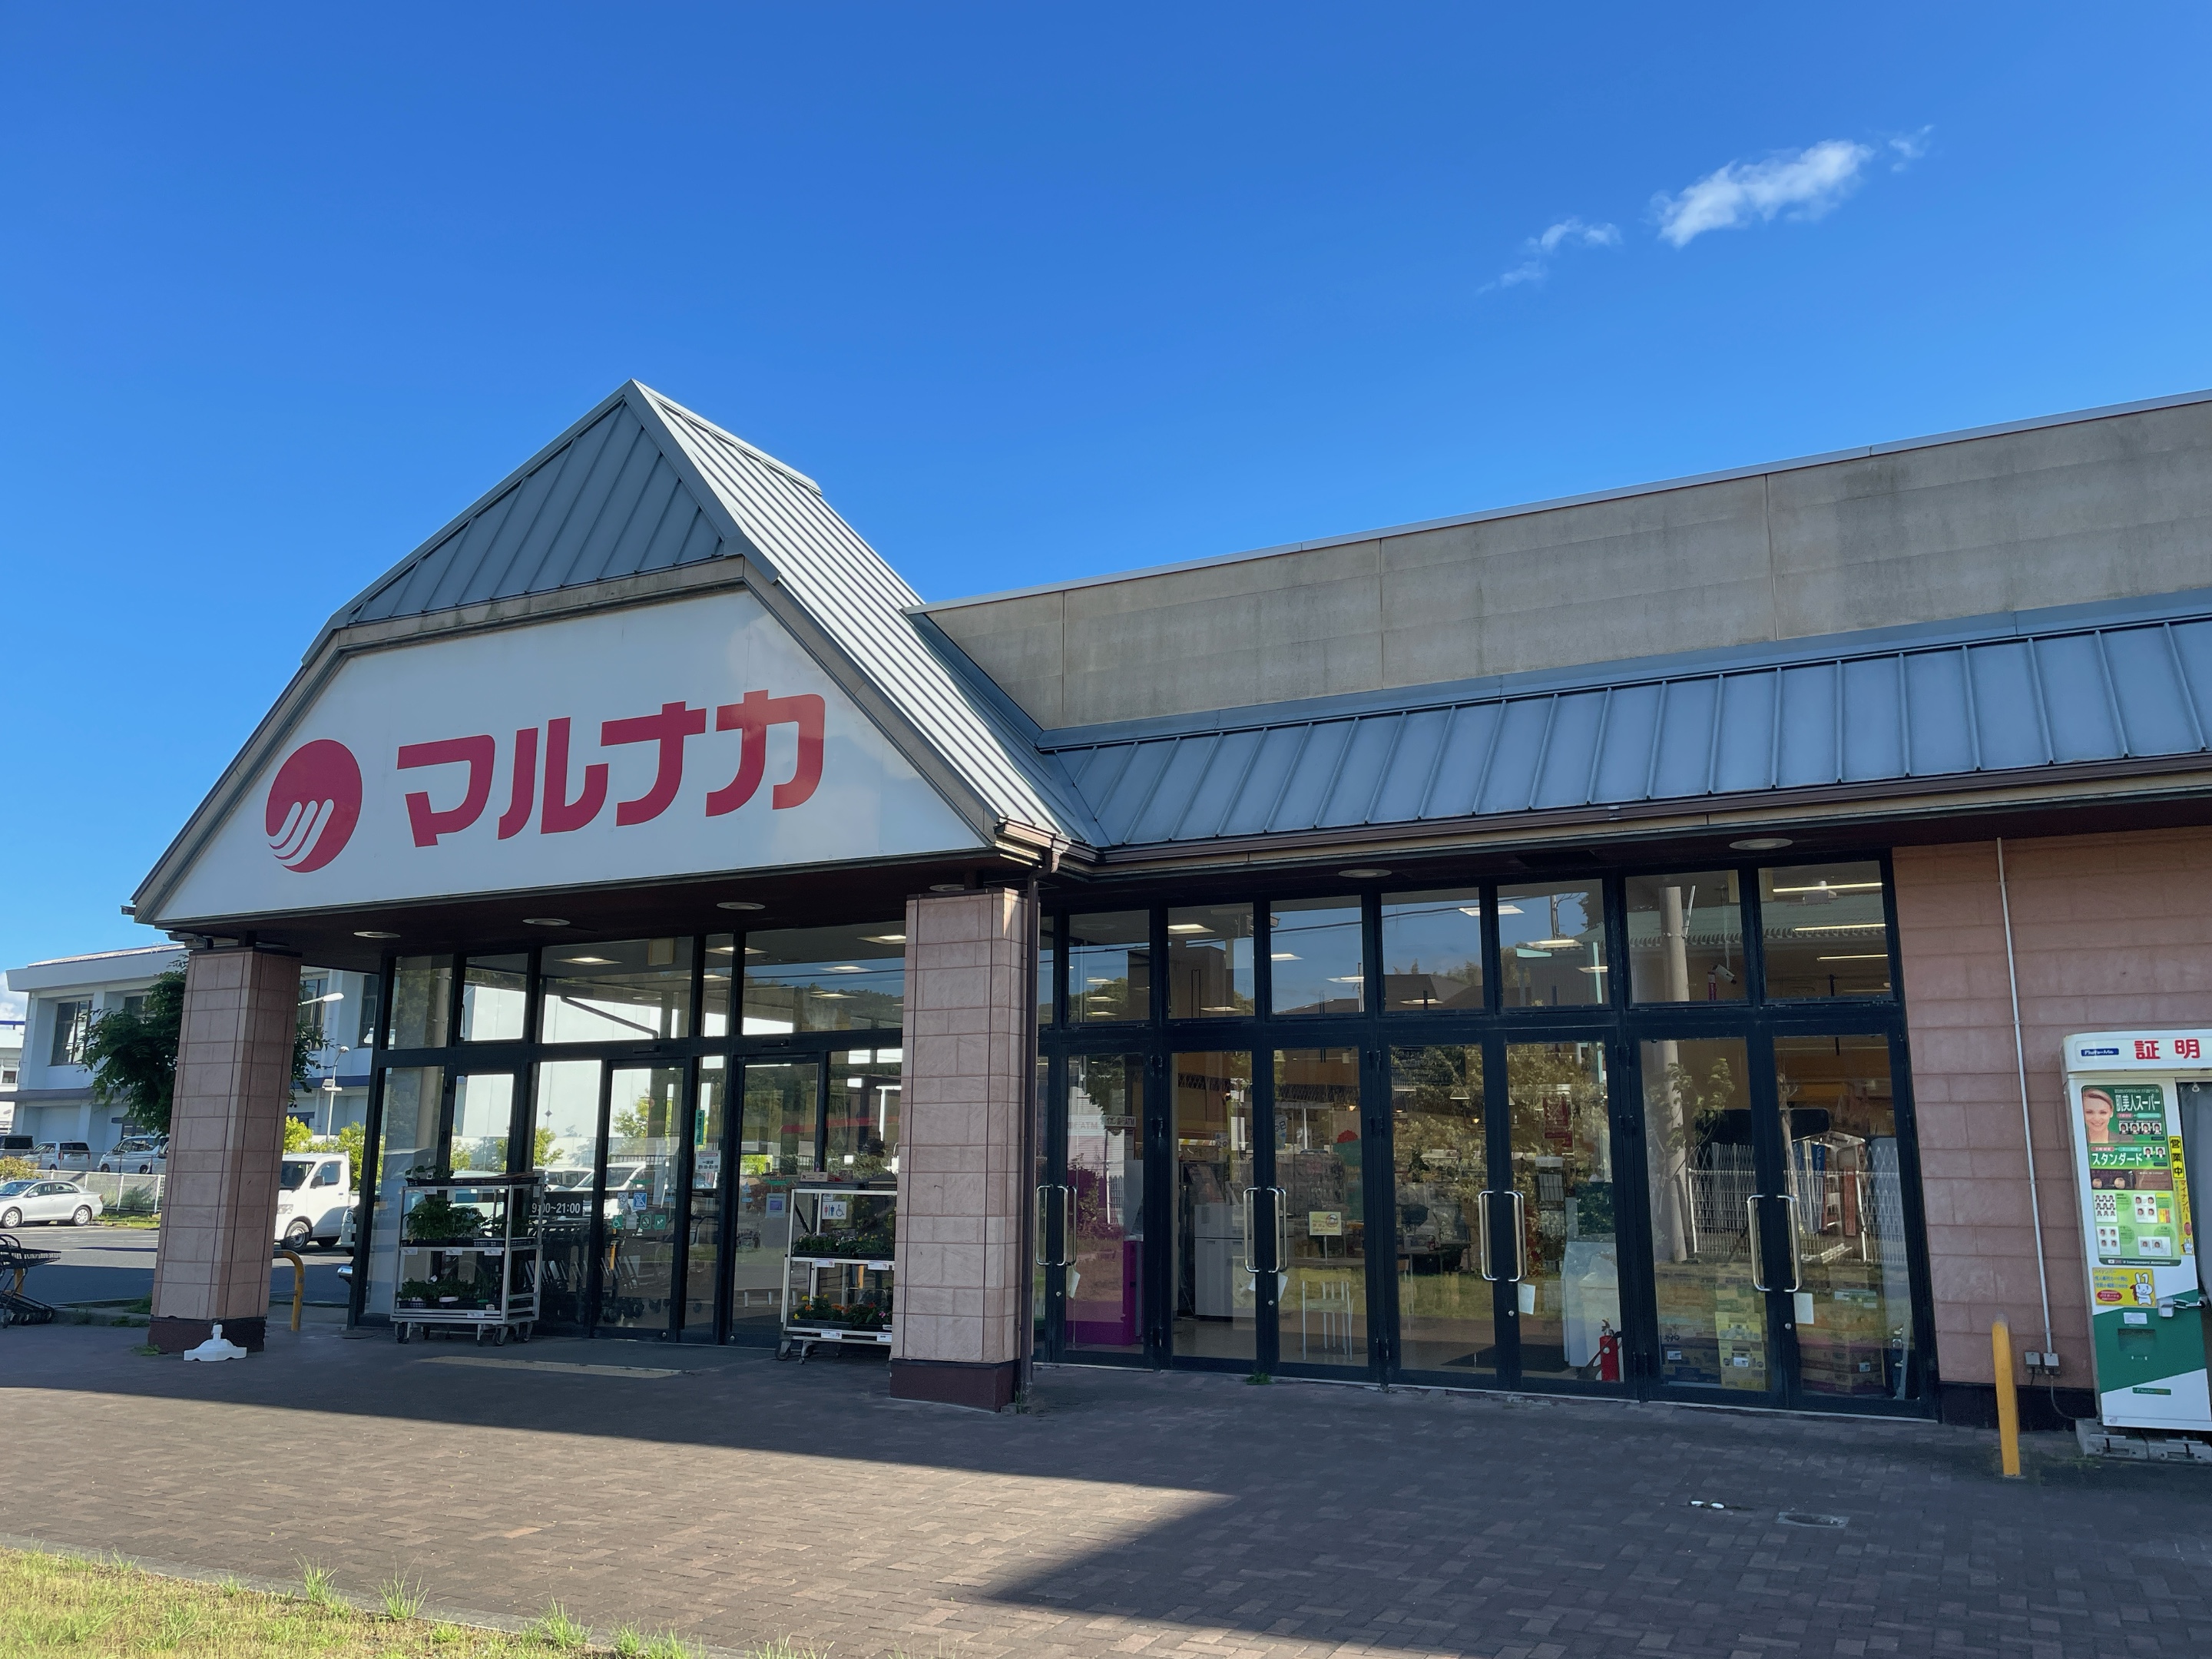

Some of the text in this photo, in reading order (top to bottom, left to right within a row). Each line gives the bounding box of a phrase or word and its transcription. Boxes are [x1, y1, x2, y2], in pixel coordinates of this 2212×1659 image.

[396, 689, 826, 849] マルナカ
[2091, 1152, 2143, 1166] スタンダード
[2170, 1138, 2183, 1177] 営業中
[531, 1203, 581, 1214] 90~21:00
